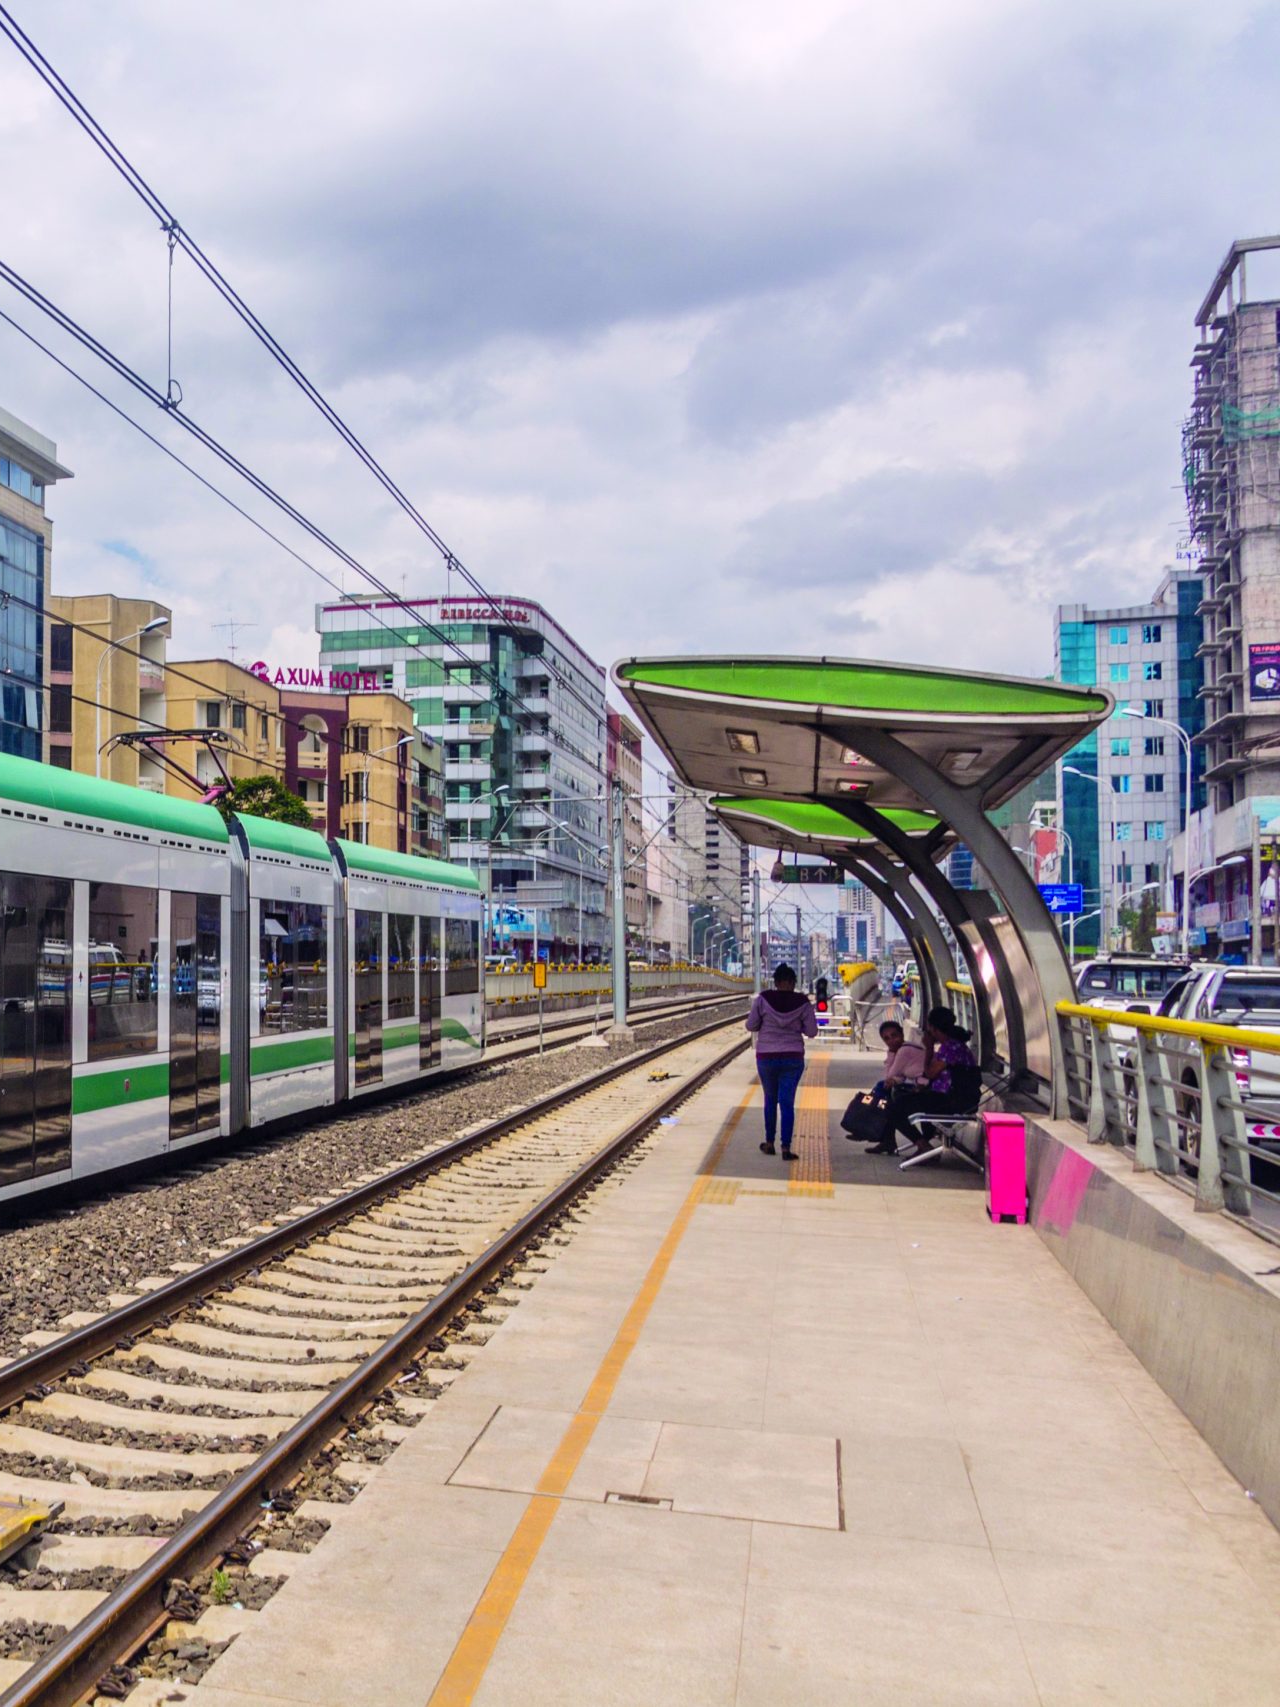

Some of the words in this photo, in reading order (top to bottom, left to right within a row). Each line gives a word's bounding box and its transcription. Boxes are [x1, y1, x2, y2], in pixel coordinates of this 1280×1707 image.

[274, 667, 324, 687] AXUM
[329, 671, 381, 691] HOTEL
[800, 867, 809, 882] B
